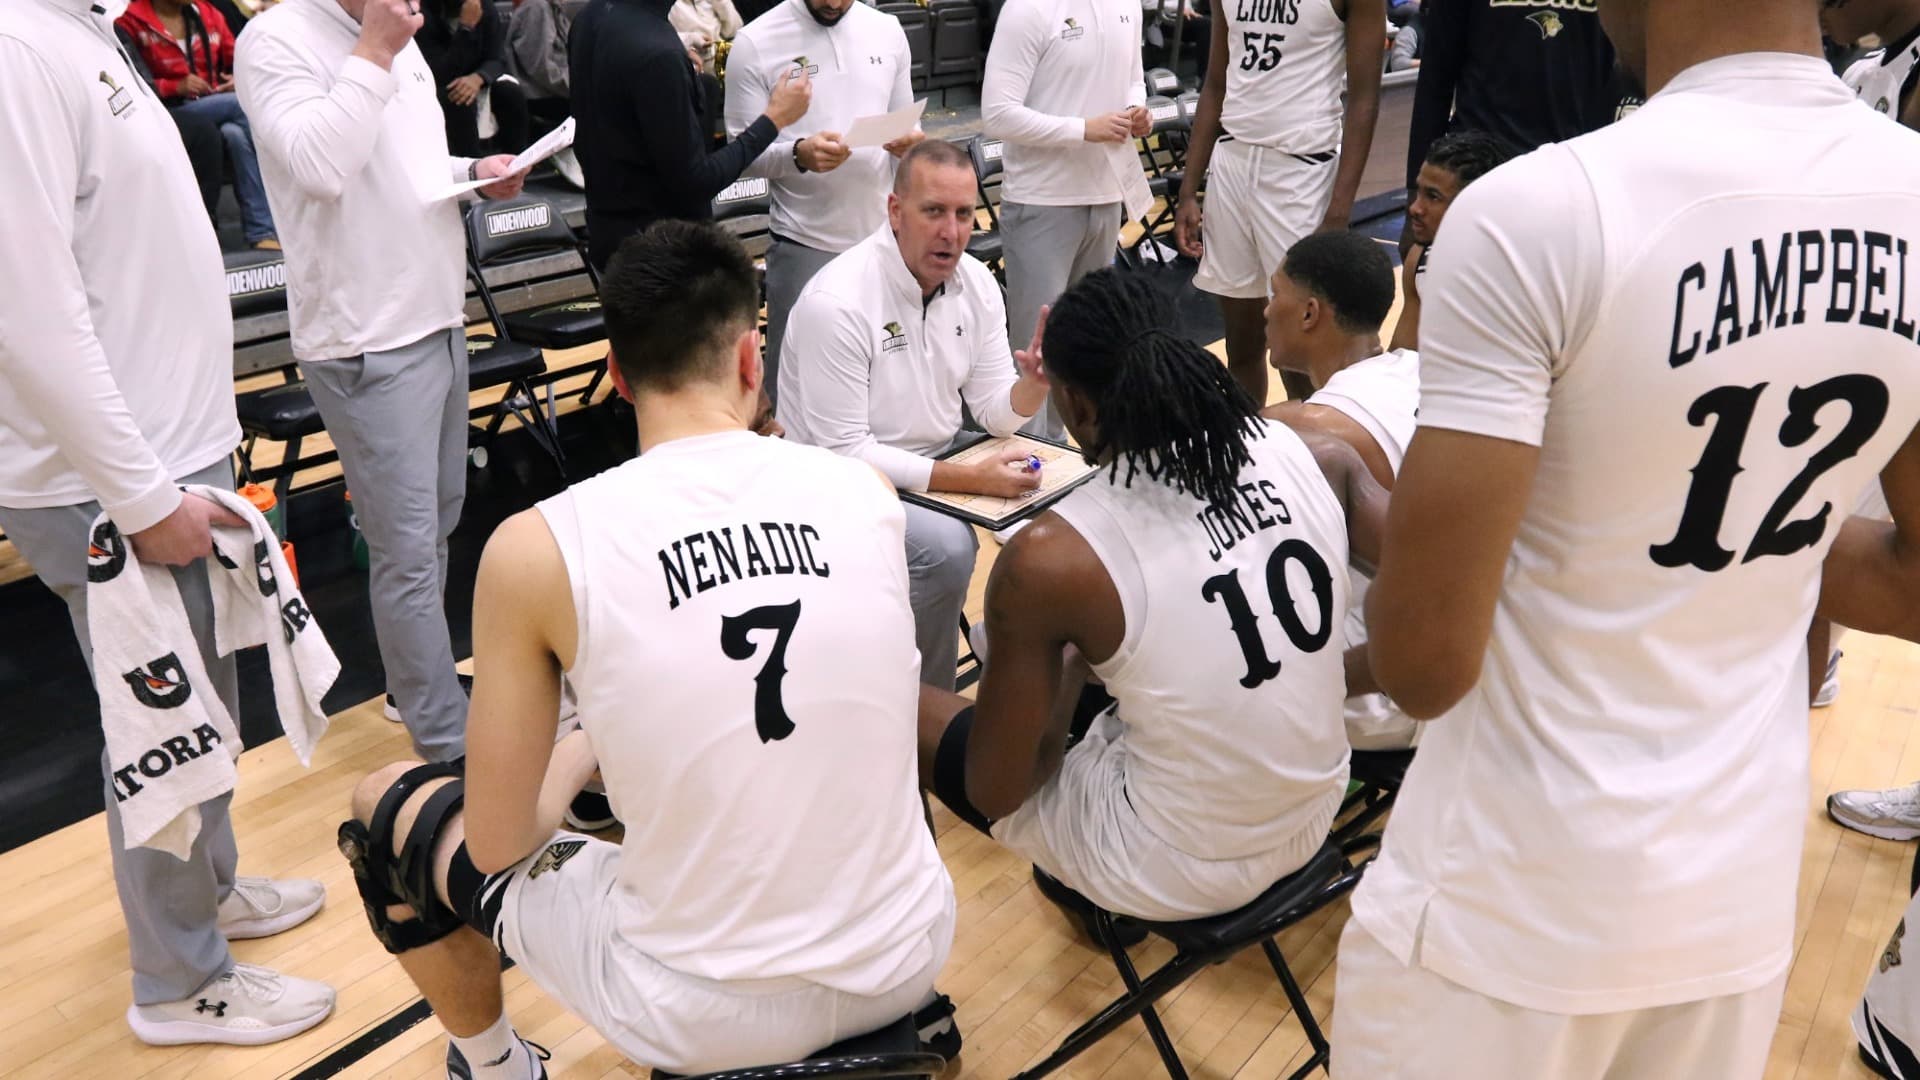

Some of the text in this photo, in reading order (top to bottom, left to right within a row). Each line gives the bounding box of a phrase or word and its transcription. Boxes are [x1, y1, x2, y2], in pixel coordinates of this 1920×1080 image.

[1236, 0, 1299, 25] LIONS
[1240, 31, 1285, 71] 55
[488, 206, 549, 234] LINDENWOOD
[1668, 228, 1920, 370] CAMPBEL
[1649, 373, 1890, 573] 12
[1196, 479, 1292, 562] JONES
[657, 522, 830, 610] NENADIC
[1201, 538, 1334, 689] 10
[720, 598, 801, 744] 7
